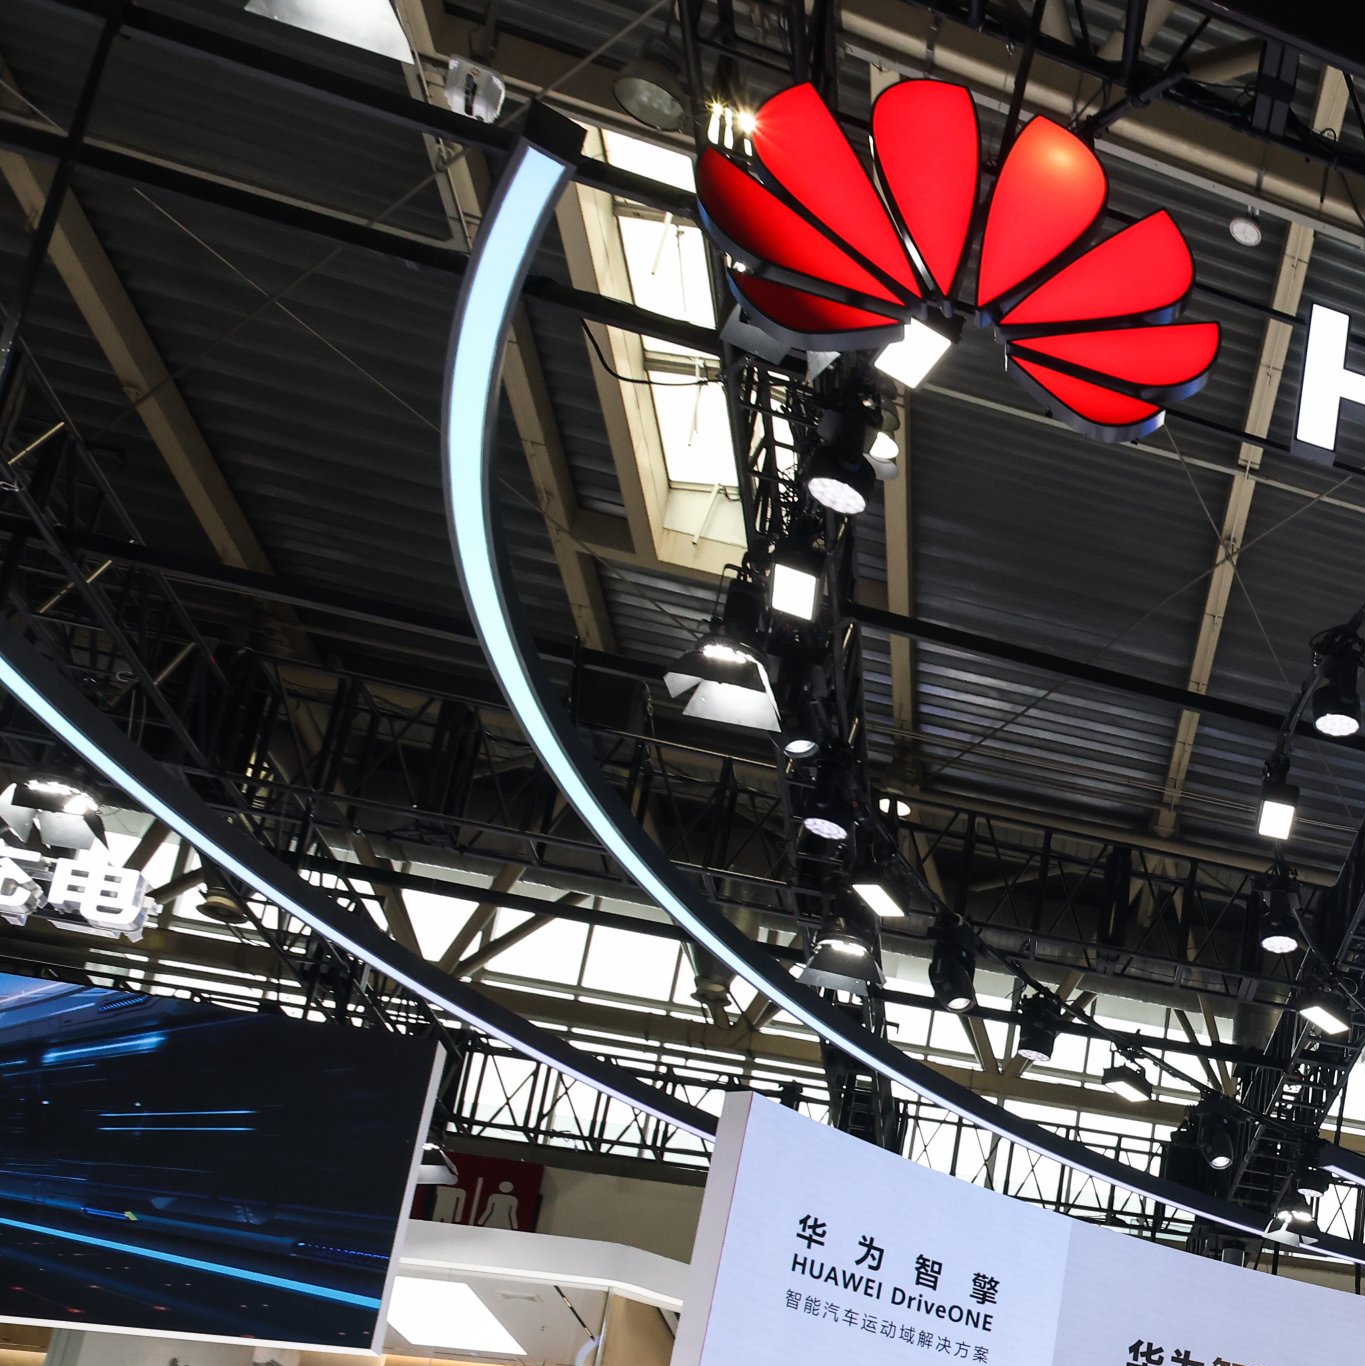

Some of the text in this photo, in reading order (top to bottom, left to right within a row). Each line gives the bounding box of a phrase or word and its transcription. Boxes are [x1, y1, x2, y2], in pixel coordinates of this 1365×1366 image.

[791, 1253, 994, 1332] HUAWEI DriveONE
[796, 1214, 1000, 1305] 华为智擎
[785, 1288, 990, 1364] 智能汽车运动域解决方案
